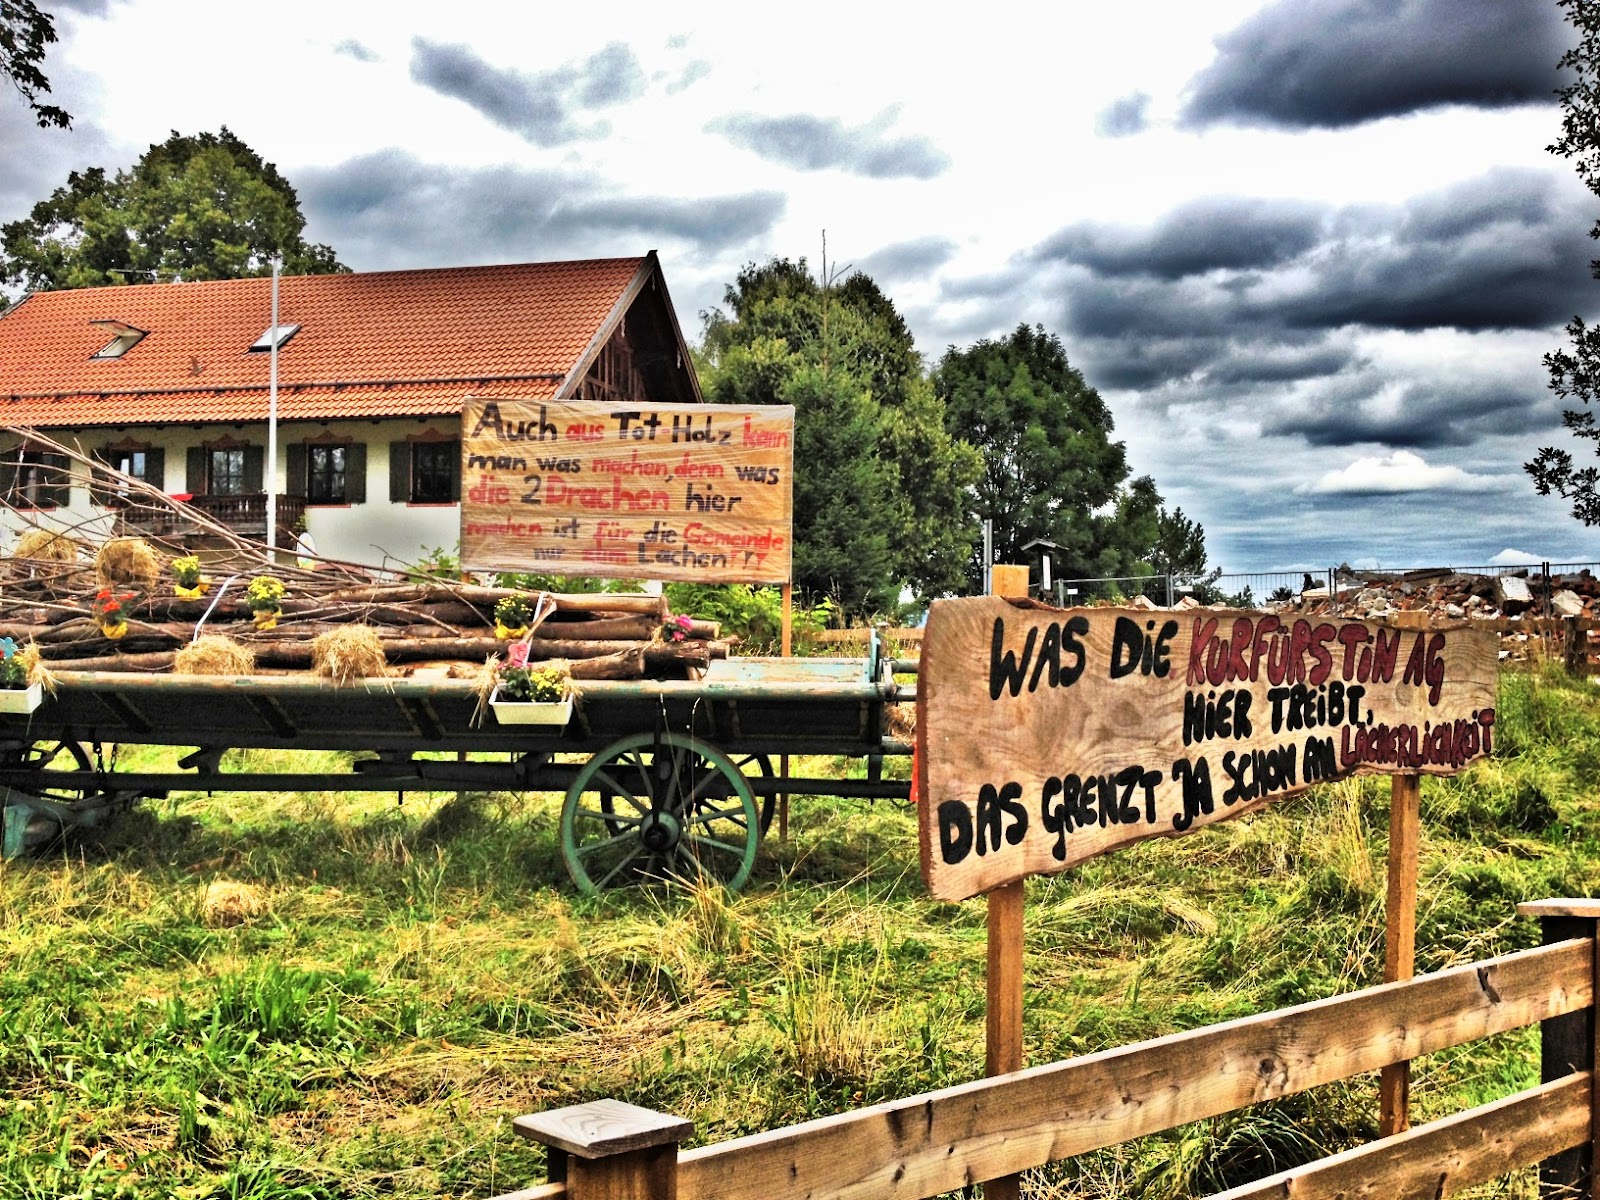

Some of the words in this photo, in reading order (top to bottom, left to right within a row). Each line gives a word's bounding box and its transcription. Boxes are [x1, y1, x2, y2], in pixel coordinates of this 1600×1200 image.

[472, 402, 557, 441] Auch
[565, 423, 606, 441] aus
[743, 415, 789, 447] kann
[468, 453, 527, 471] man
[536, 457, 581, 472] was
[735, 466, 780, 485] was
[468, 475, 510, 504] die
[521, 474, 542, 504] 2
[545, 475, 670, 511] Drachen
[686, 482, 742, 512] hier
[553, 517, 580, 539] ist
[593, 521, 634, 549] für
[644, 521, 677, 543] die
[683, 522, 783, 550] Gemeinde
[989, 616, 1089, 700] WAS
[1403, 631, 1446, 706] AG
[937, 782, 1028, 865] DAS
[1041, 765, 1163, 861] GRENZT
[1172, 756, 1214, 831] JA
[1222, 743, 1296, 806] SCHON
[1303, 735, 1338, 783] AN
